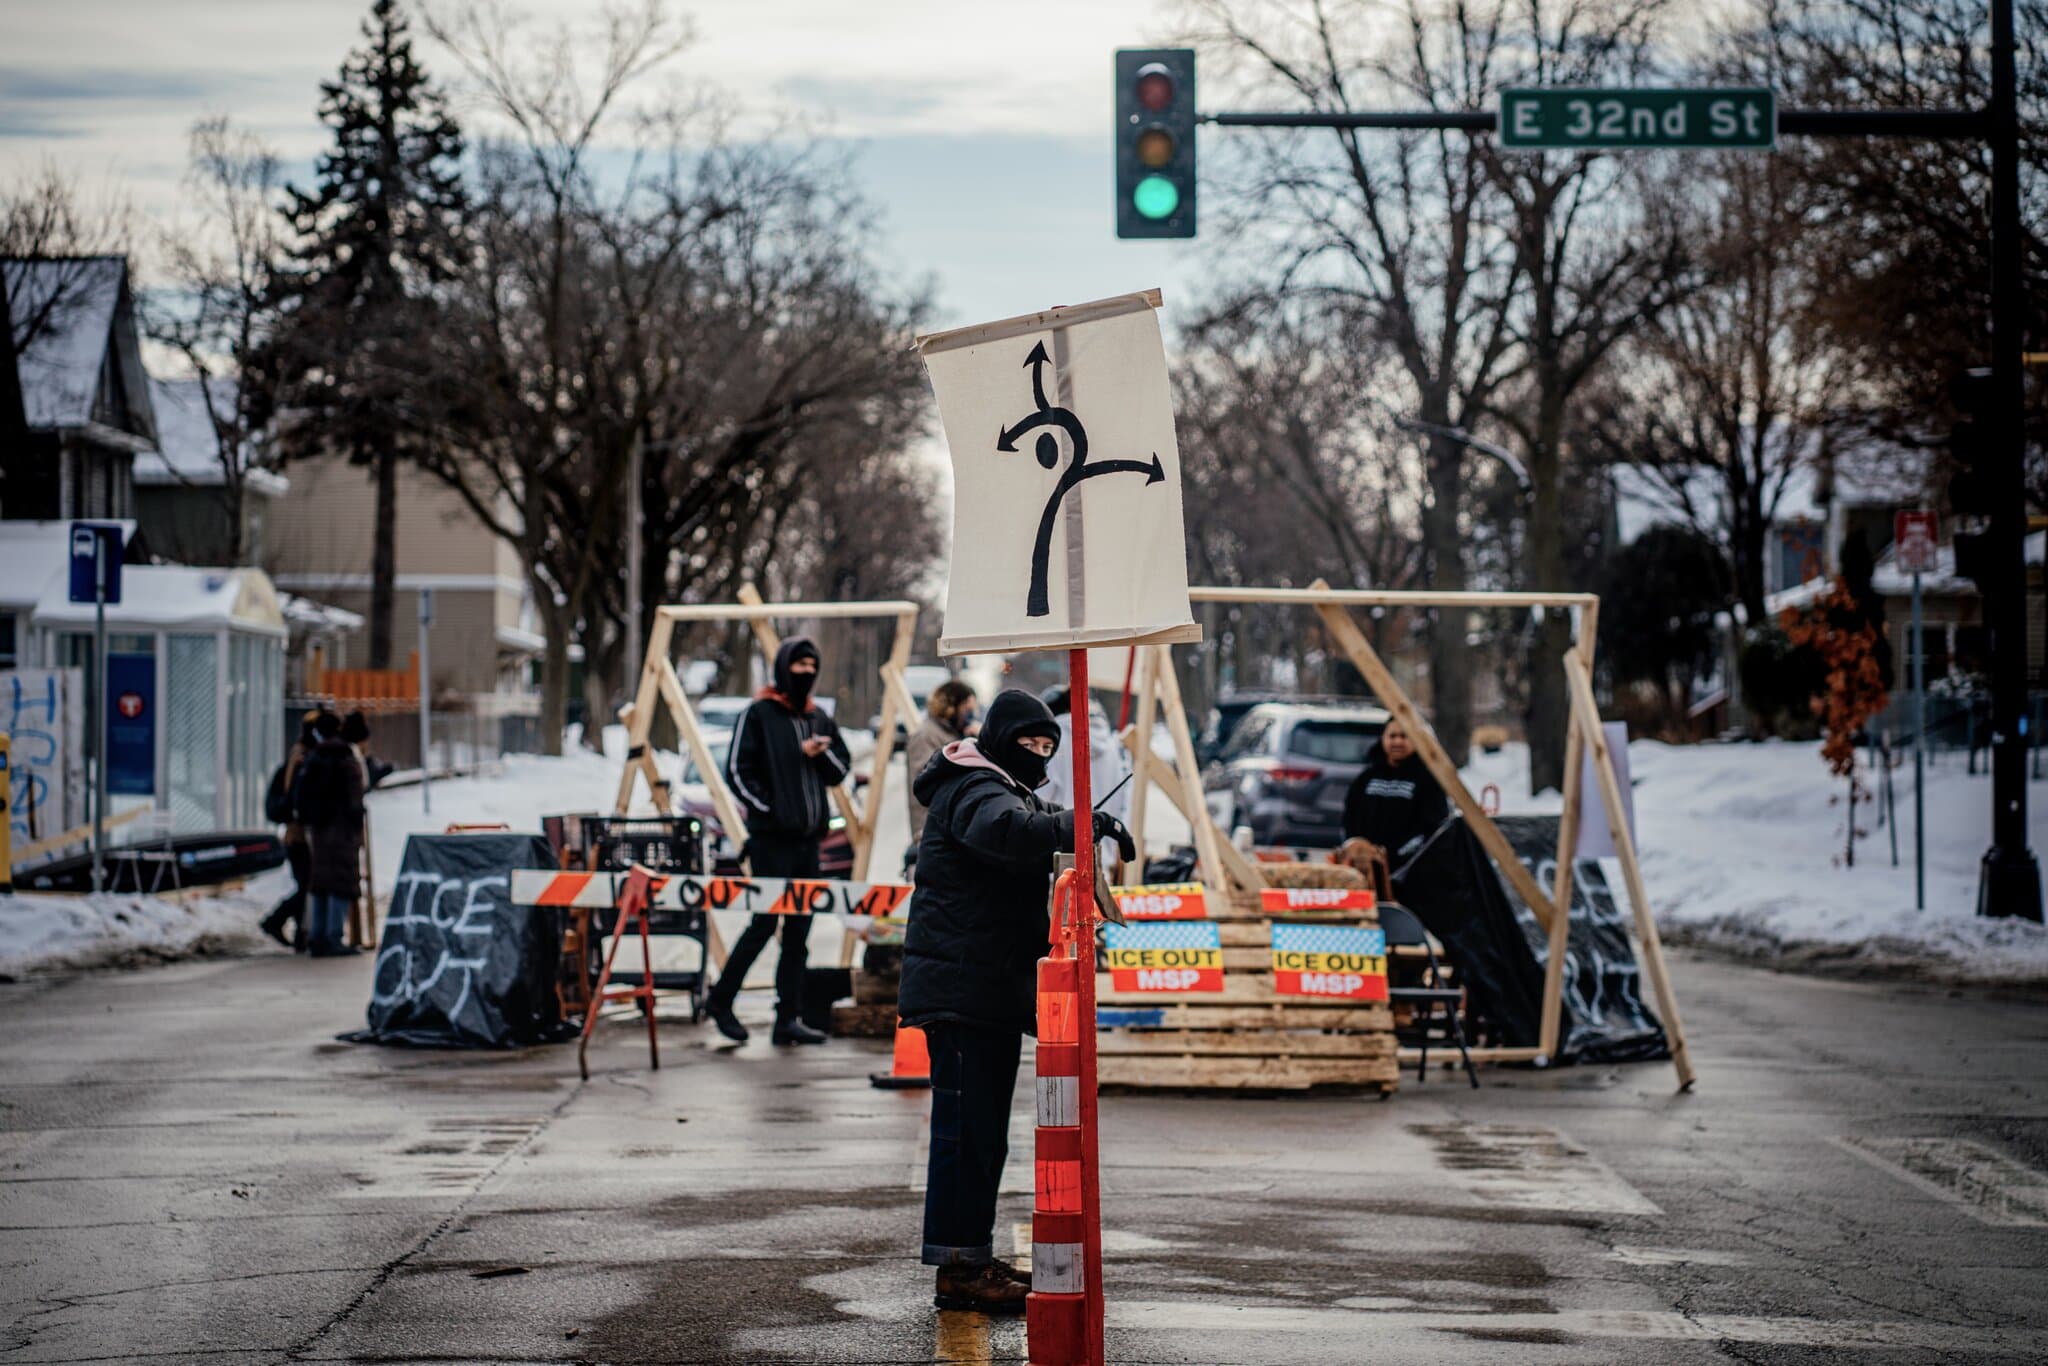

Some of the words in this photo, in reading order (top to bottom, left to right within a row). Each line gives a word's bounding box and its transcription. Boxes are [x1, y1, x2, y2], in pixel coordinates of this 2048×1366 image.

[1513, 101, 1542, 137] E
[1565, 101, 1687, 138] 32nd
[1709, 101, 1760, 137] St
[386, 870, 508, 934] ICE
[679, 876, 762, 912] OUT
[782, 880, 898, 917] NOW!
[1120, 895, 1182, 915] MSP
[1287, 889, 1349, 907] MSP
[1112, 950, 1155, 966] ICE
[1162, 950, 1217, 966] OUT
[1277, 952, 1319, 969] ICE
[1326, 954, 1380, 972] OUT
[374, 944, 487, 1022] OUT
[1136, 969, 1200, 990] MSP
[1300, 972, 1364, 994] MSP
